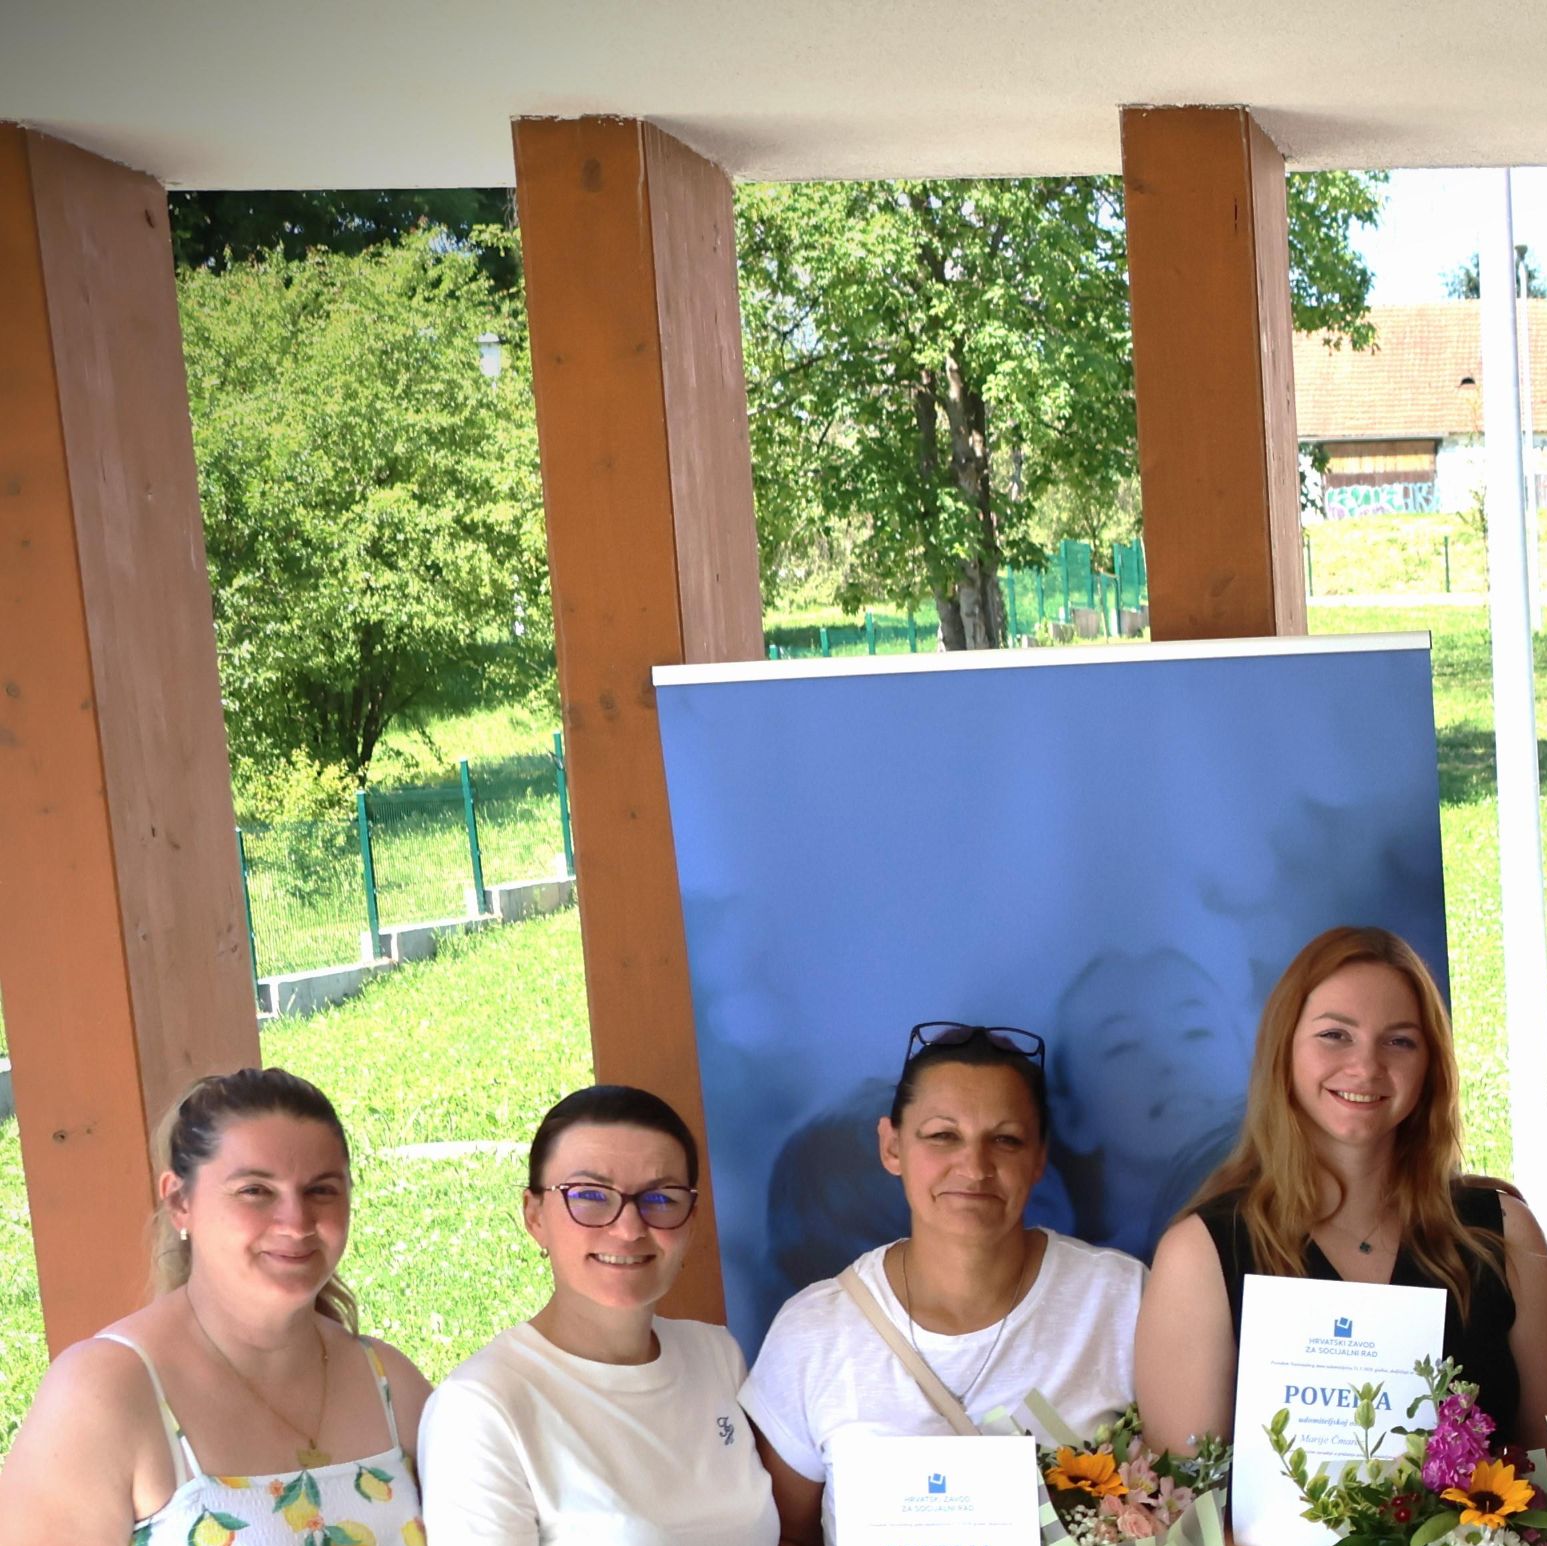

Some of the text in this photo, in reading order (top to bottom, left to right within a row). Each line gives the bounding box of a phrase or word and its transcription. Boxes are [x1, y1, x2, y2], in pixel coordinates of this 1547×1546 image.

[1348, 1340, 1376, 1348] ZAVOD
[1318, 1347, 1360, 1356] SOCIJALNI
[1361, 1350, 1378, 1358] RAD
[1284, 1385, 1392, 1410] POVEA
